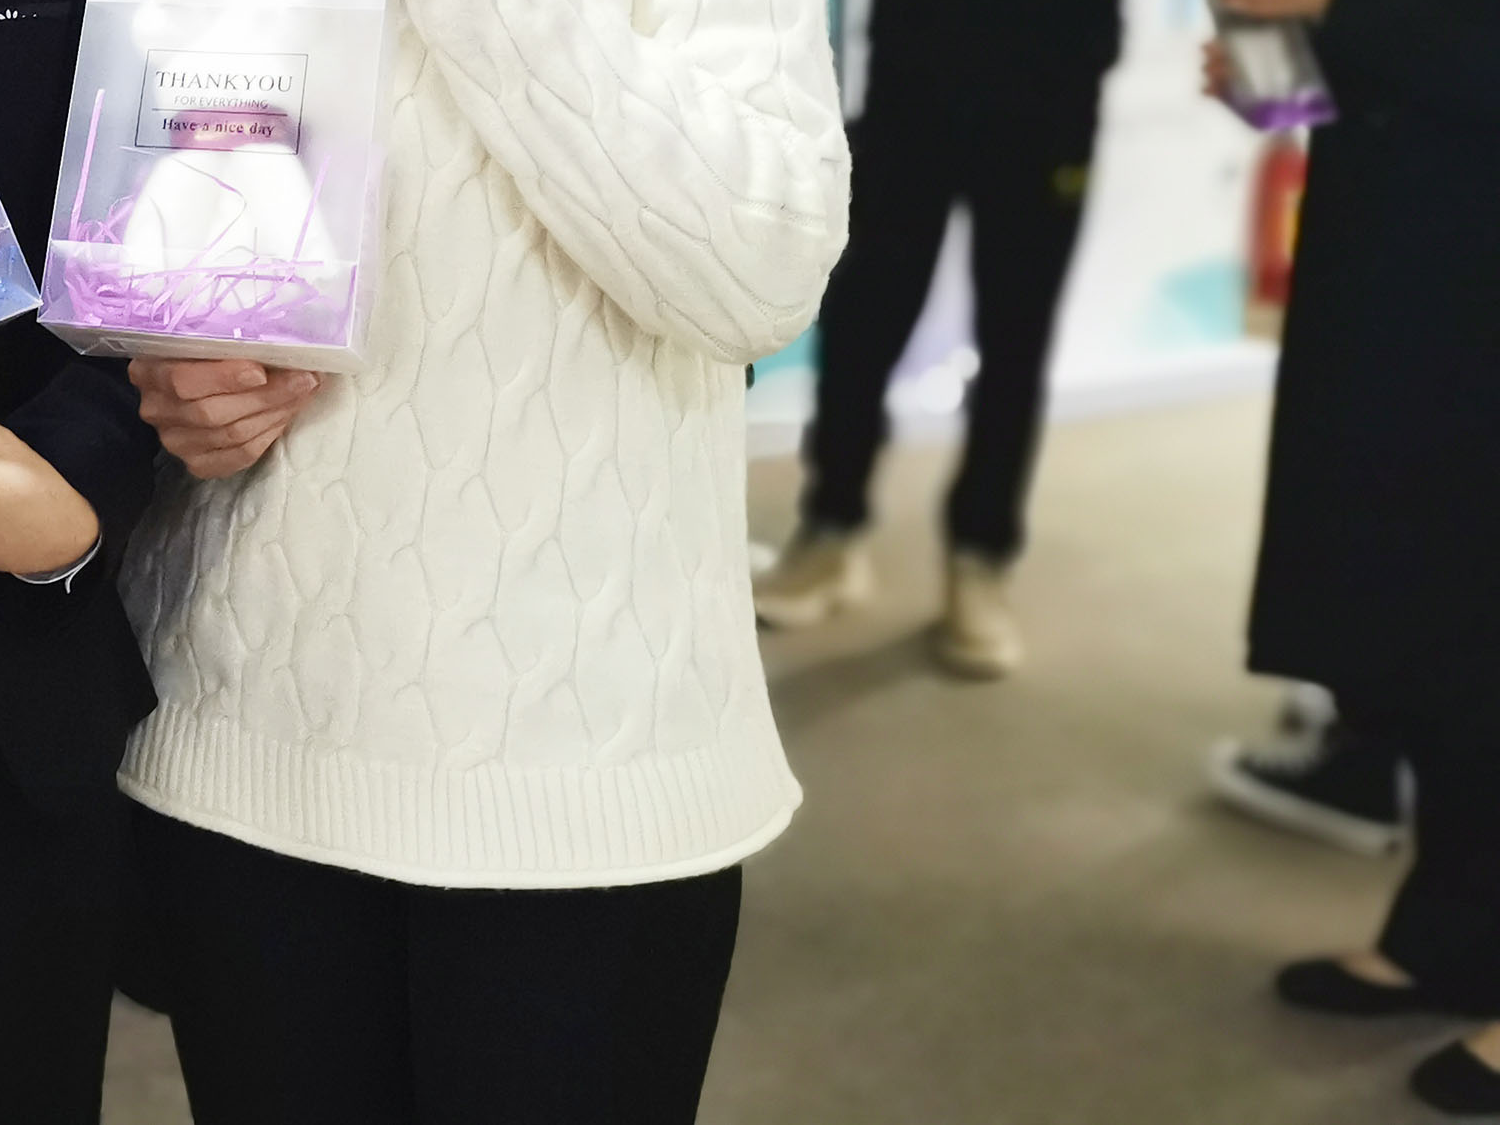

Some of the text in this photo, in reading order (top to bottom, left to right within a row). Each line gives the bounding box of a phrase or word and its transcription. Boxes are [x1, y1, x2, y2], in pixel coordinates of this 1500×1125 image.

[155, 70, 293, 93] THANKYOU
[174, 95, 269, 110] FOR EVERYTHING
[162, 118, 276, 138] Have a nice day
